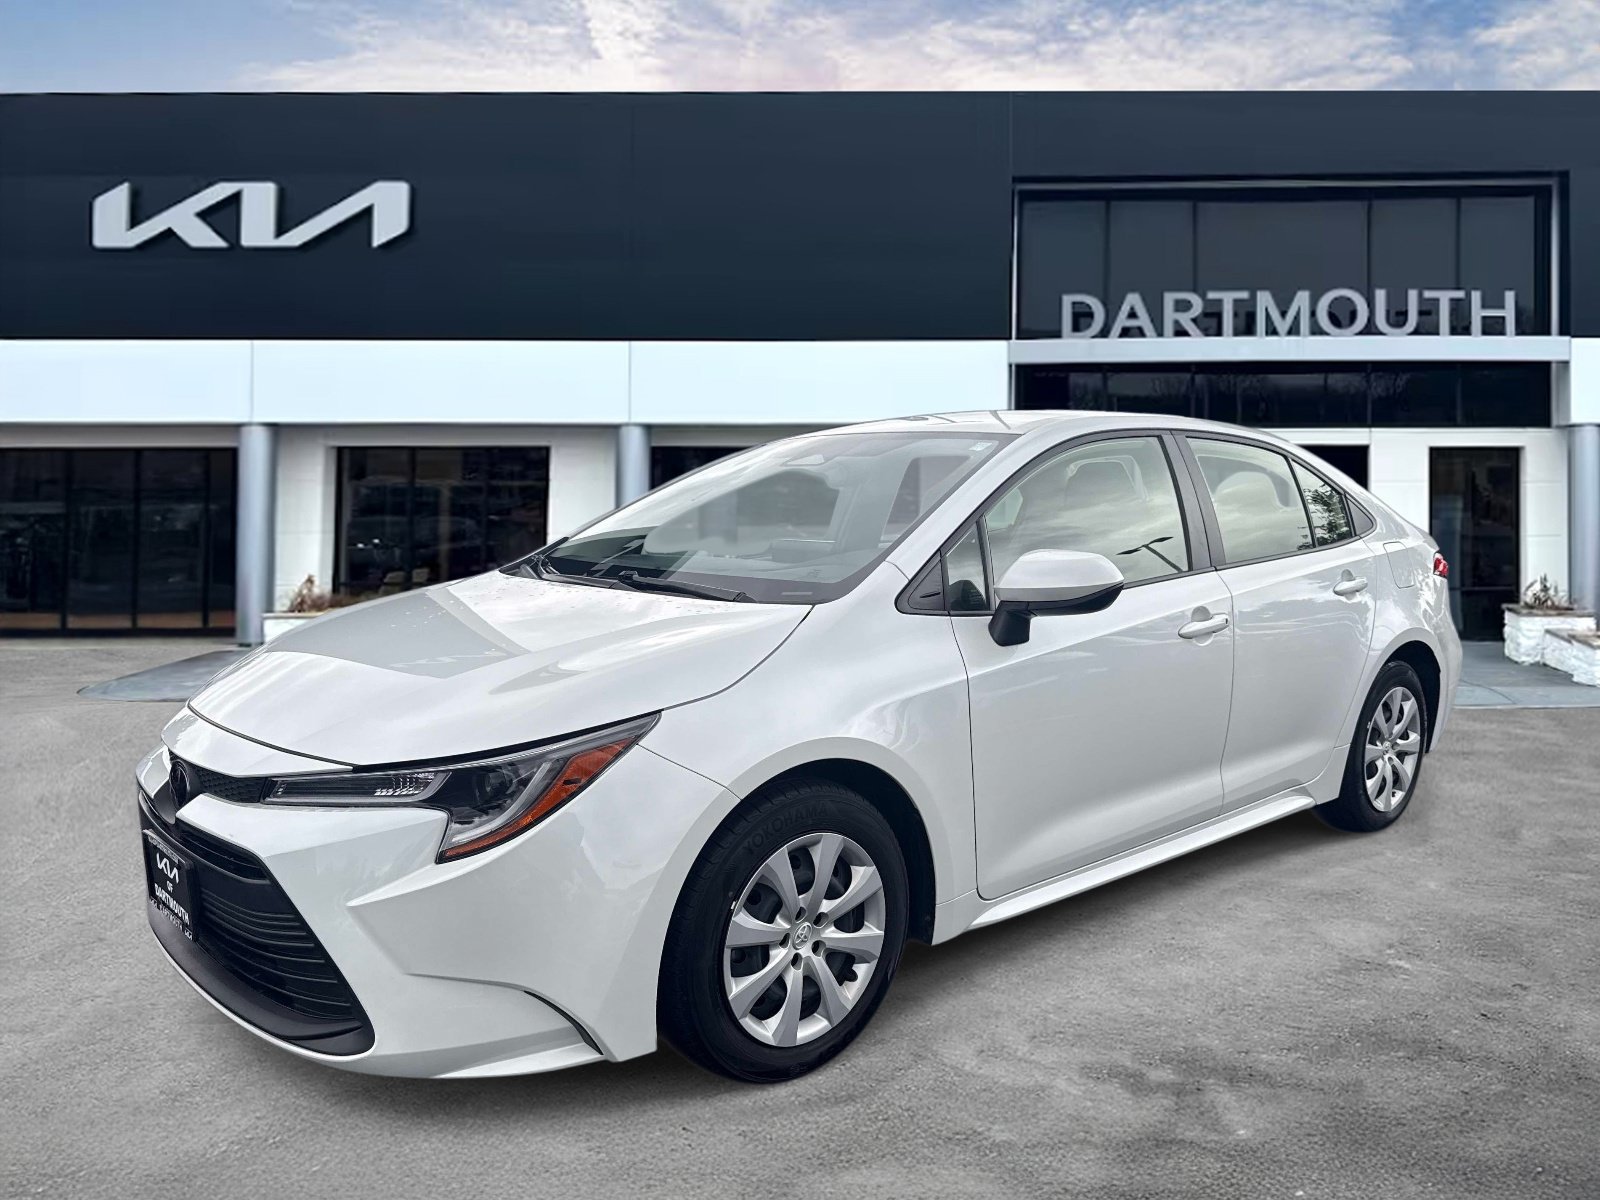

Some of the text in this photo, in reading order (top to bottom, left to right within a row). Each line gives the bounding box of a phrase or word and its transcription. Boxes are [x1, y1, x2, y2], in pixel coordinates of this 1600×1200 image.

[92, 181, 410, 248] KIA
[1060, 288, 1516, 339] DARTMOUTH
[743, 801, 829, 855] YOKOHAMA
[156, 852, 179, 884] KIA
[166, 880, 174, 893] OF
[154, 882, 190, 925] DARTMOUTH
